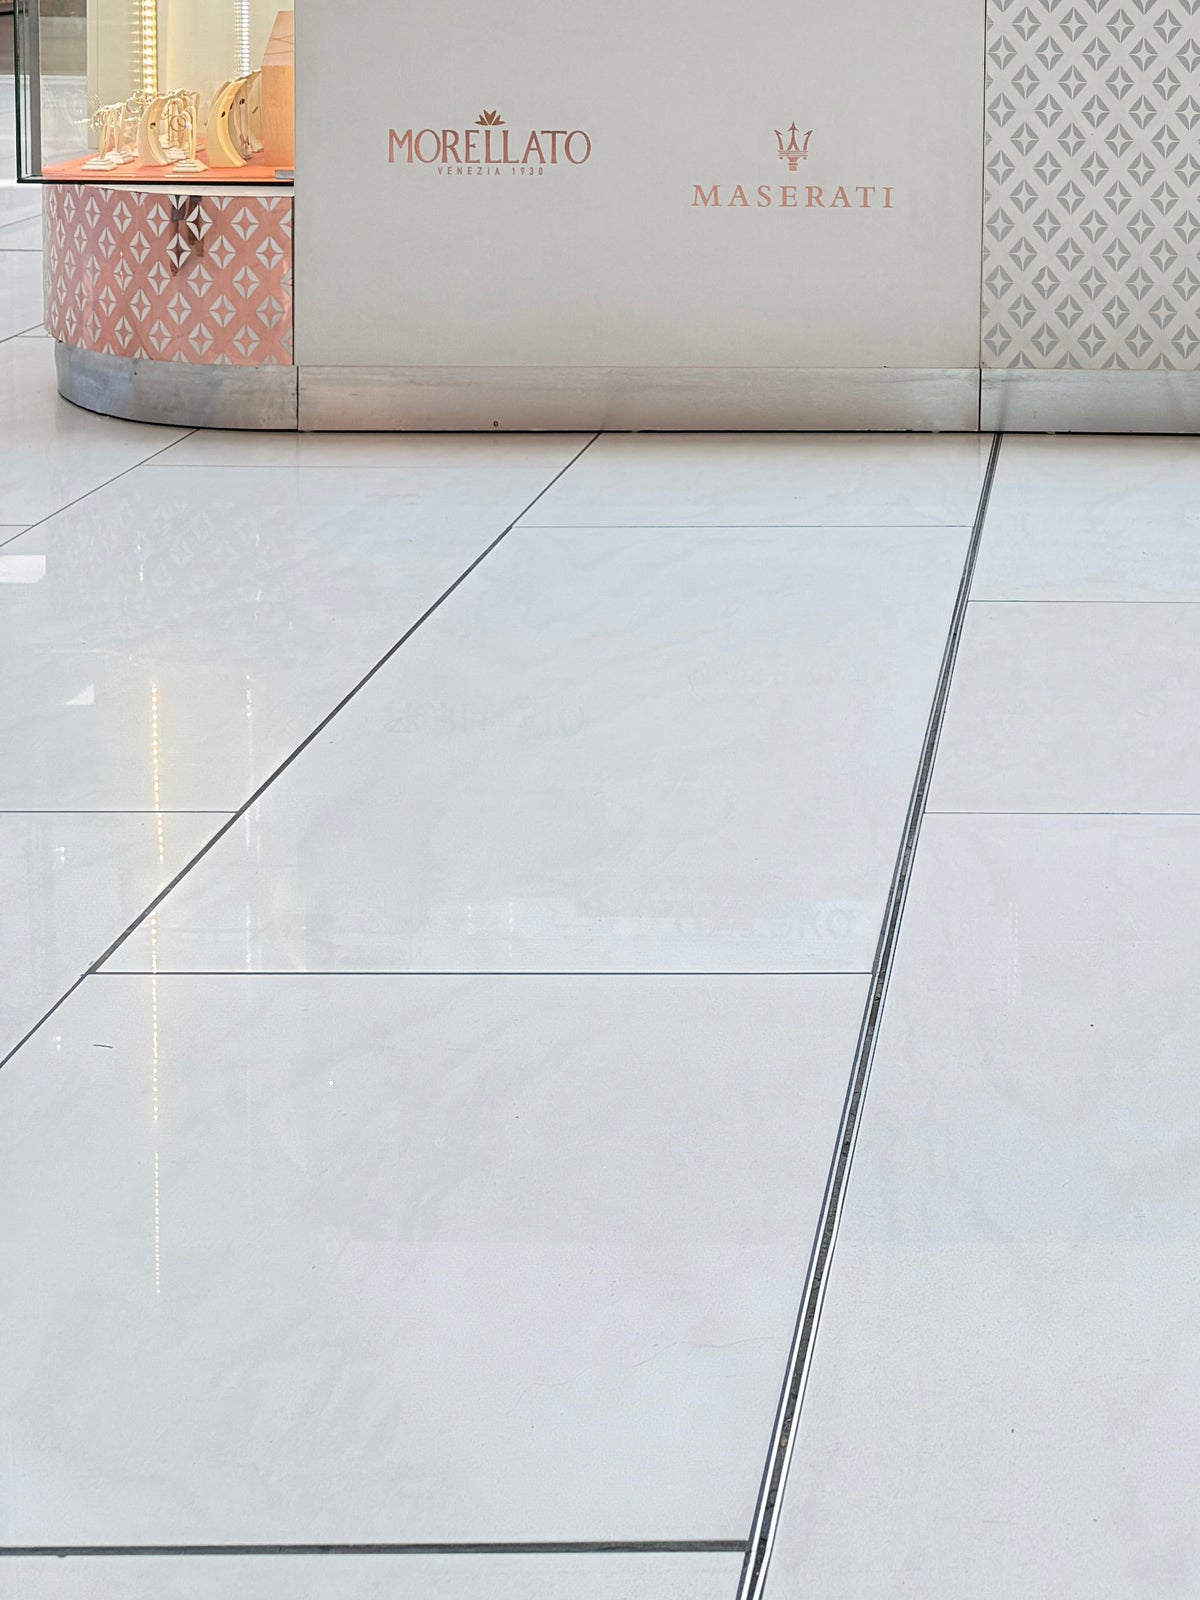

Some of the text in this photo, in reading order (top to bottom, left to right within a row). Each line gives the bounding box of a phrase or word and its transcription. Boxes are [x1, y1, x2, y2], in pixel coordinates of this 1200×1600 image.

[388, 128, 592, 166] MORELLATO
[437, 165, 545, 176] VENEZIA 1930
[690, 183, 895, 210] MASERATI
